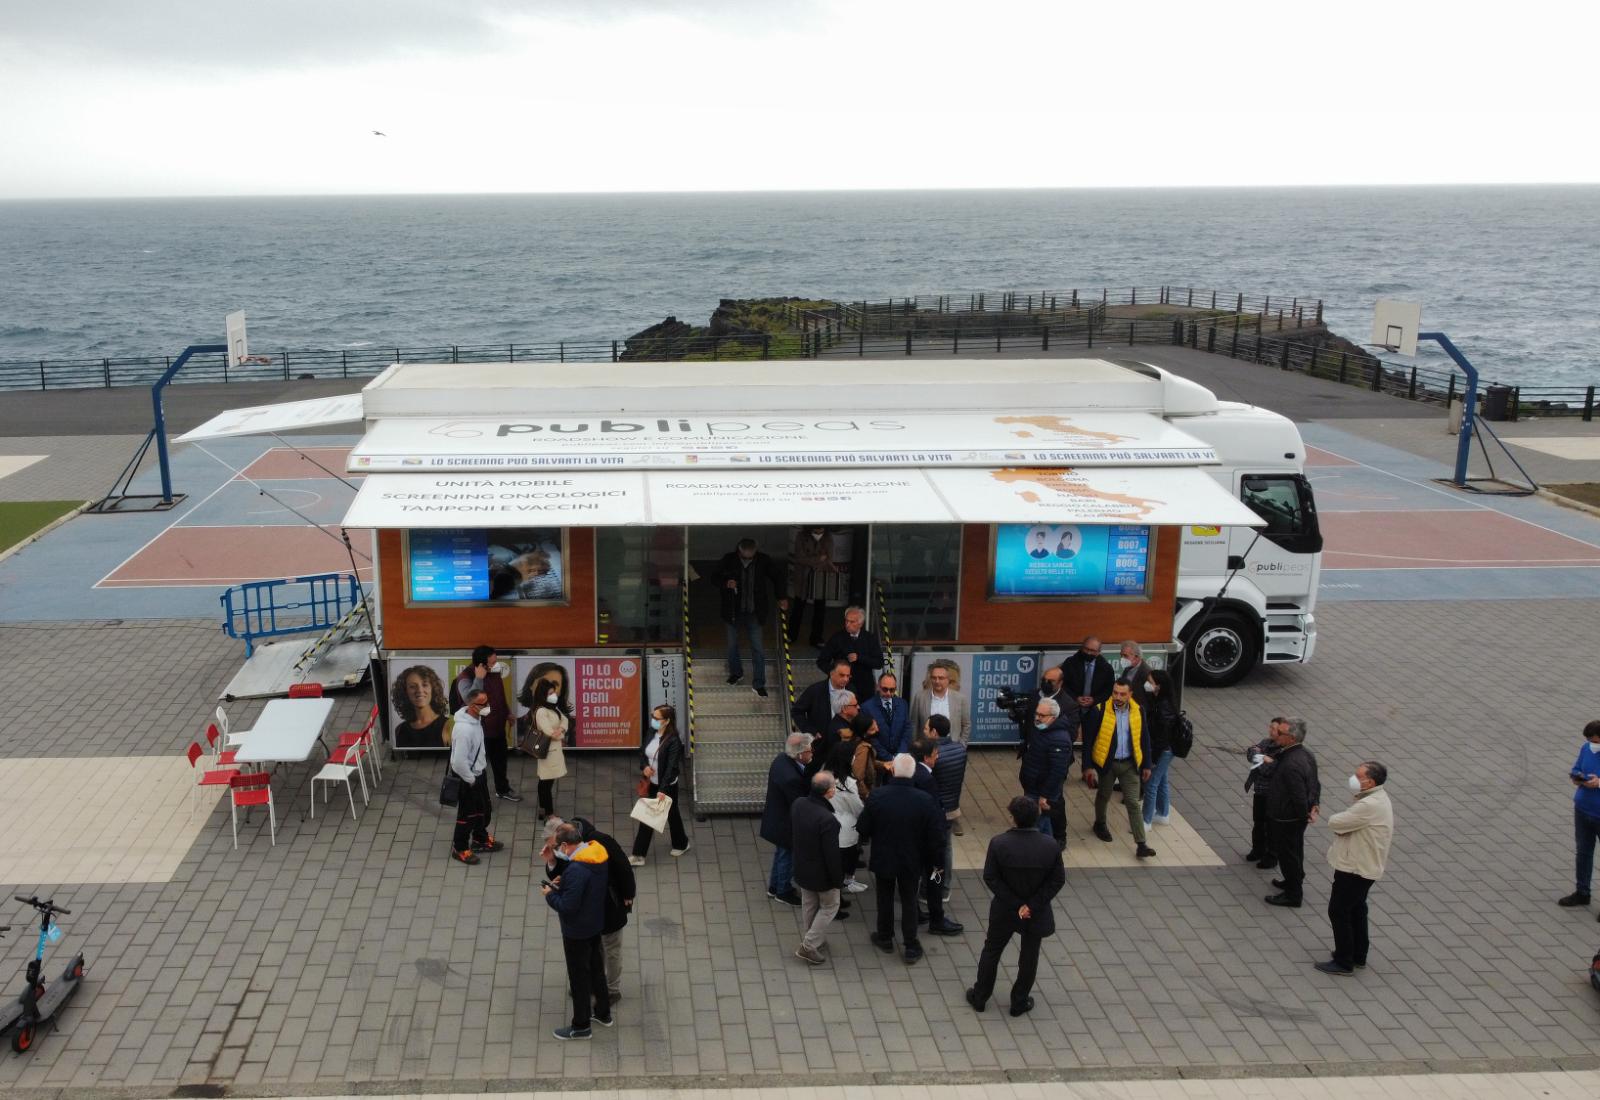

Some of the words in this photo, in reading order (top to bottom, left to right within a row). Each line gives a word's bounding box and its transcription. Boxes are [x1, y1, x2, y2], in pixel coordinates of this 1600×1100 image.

[496, 419, 906, 437] publipeas
[431, 458, 442, 466] LO
[447, 457, 504, 465] SCREENING
[531, 456, 582, 465] SALVARTI
[584, 456, 598, 465] LA
[601, 456, 624, 464] VITA
[759, 455, 772, 463] LO
[775, 454, 832, 463] SCREENING
[858, 453, 911, 462] SALVARTI
[912, 453, 925, 461] LA
[928, 452, 952, 461] VITA
[1033, 452, 1046, 460] LO
[1050, 452, 1108, 460] SCREENING
[1134, 451, 1185, 460] SALVARTI
[1187, 451, 1201, 459] LA
[435, 479, 495, 487] UNITÀ
[499, 479, 574, 487] MOBILE
[381, 492, 496, 501] SCREENING
[499, 489, 627, 500] ONCOLOGICI
[400, 503, 495, 512] TAMPONI
[516, 503, 600, 511] VACCINI
[1256, 562, 1309, 573] publipeas
[582, 664, 593, 676] IO
[597, 664, 611, 676] LO
[979, 659, 991, 672] IO
[994, 659, 1008, 672] LO
[582, 678, 623, 690] FACCIO
[978, 673, 1020, 686] FACCIO
[582, 692, 609, 704] OGNI
[582, 705, 590, 717] 2
[594, 705, 620, 717] ANNI
[977, 701, 984, 713] 2
